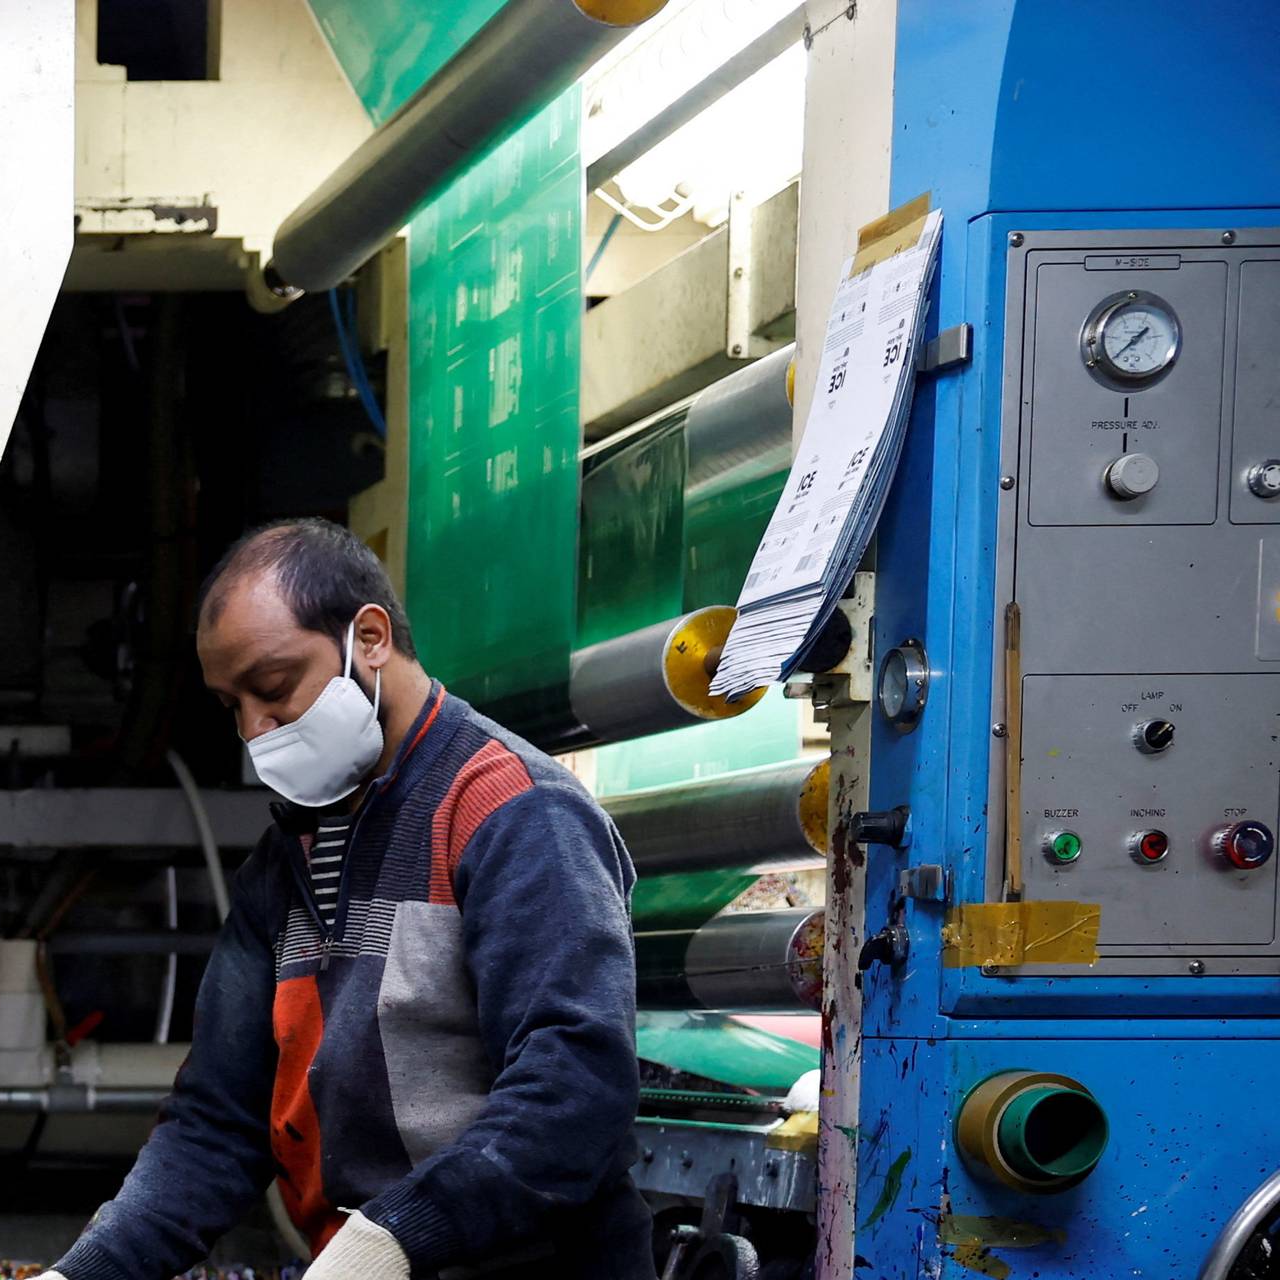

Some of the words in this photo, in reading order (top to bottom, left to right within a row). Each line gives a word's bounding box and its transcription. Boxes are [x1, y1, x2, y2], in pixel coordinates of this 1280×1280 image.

[828, 369, 847, 393] ICE
[1091, 421, 1138, 430] PRESSURE
[1141, 692, 1165, 700] LAMP
[1121, 704, 1139, 712] OFF
[1169, 704, 1183, 712] ON
[1044, 809, 1079, 818] BUZZER
[1130, 809, 1166, 817] INCHING
[1223, 808, 1248, 816] STOP
